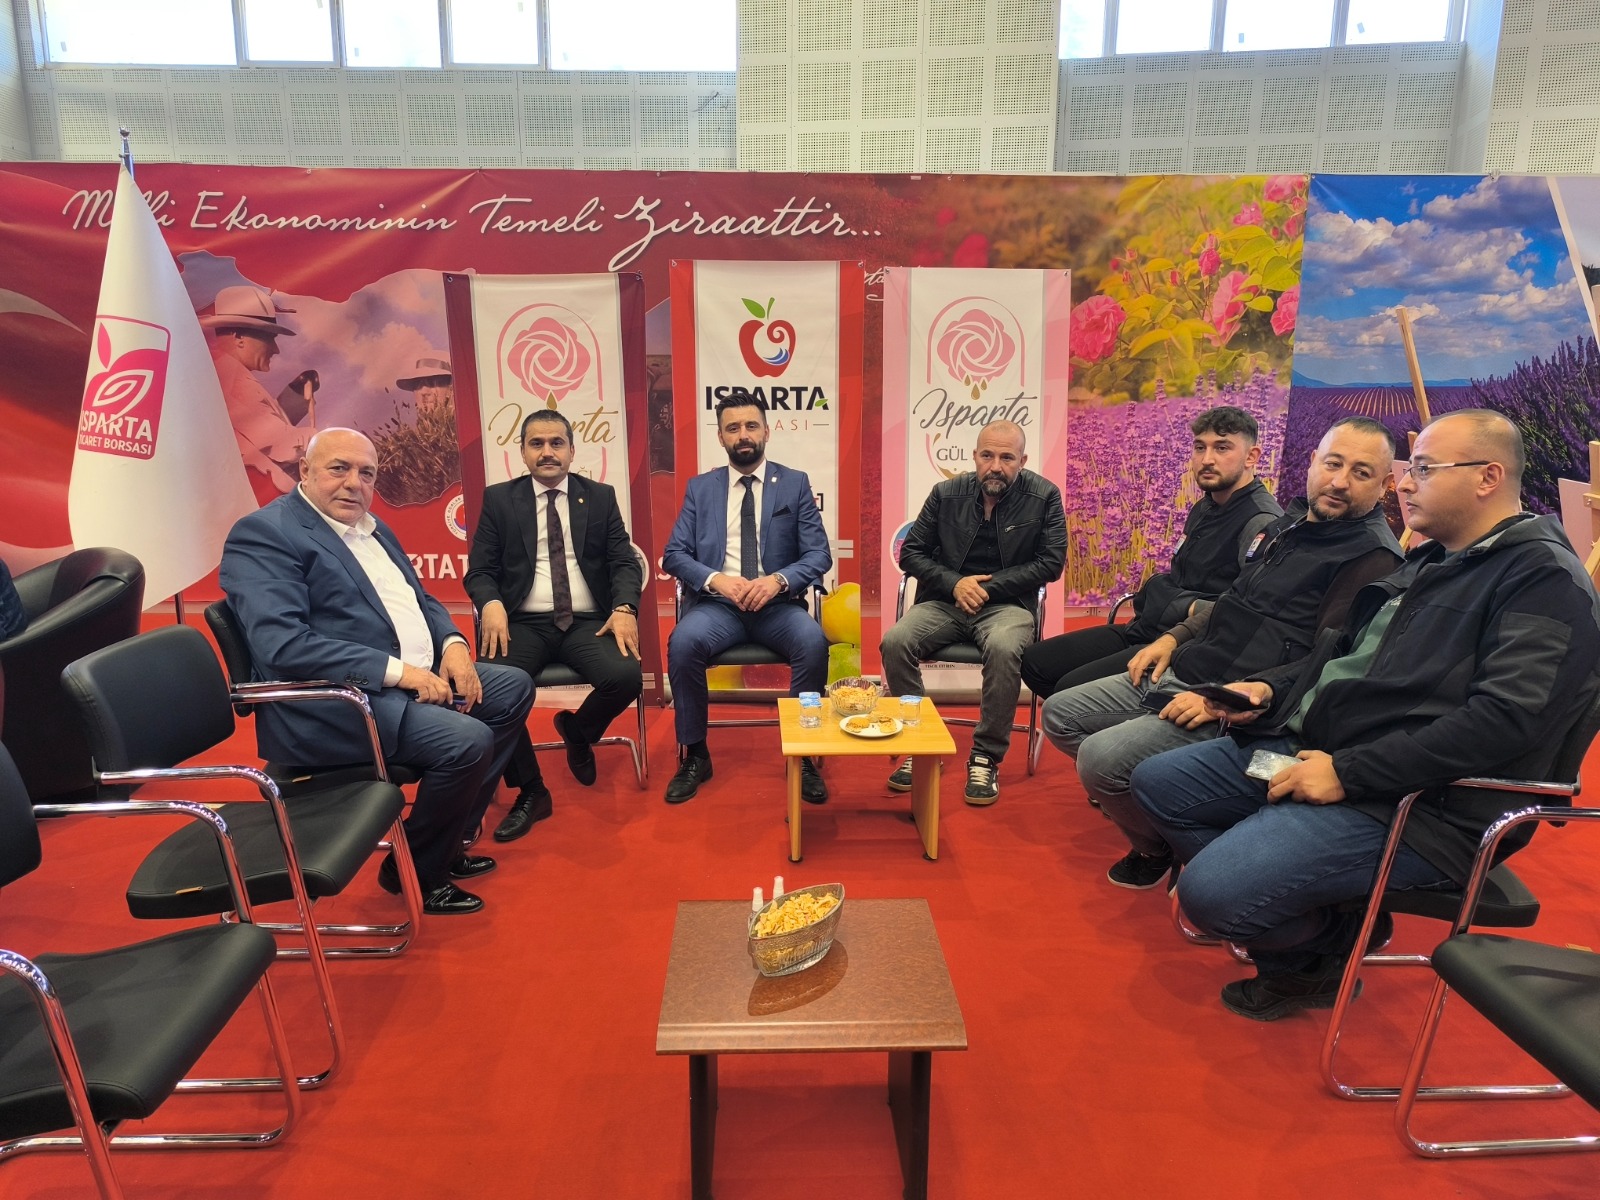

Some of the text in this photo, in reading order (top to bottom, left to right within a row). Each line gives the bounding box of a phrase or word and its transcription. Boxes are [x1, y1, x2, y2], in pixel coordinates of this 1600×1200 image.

[62, 189, 882, 272] Mli Ekonominin Temeli Ziraattir...
[80, 409, 153, 442] ISPARTA
[912, 388, 1038, 440] Isparta
[103, 437, 152, 456] BORSASI
[936, 445, 968, 461] GÜL
